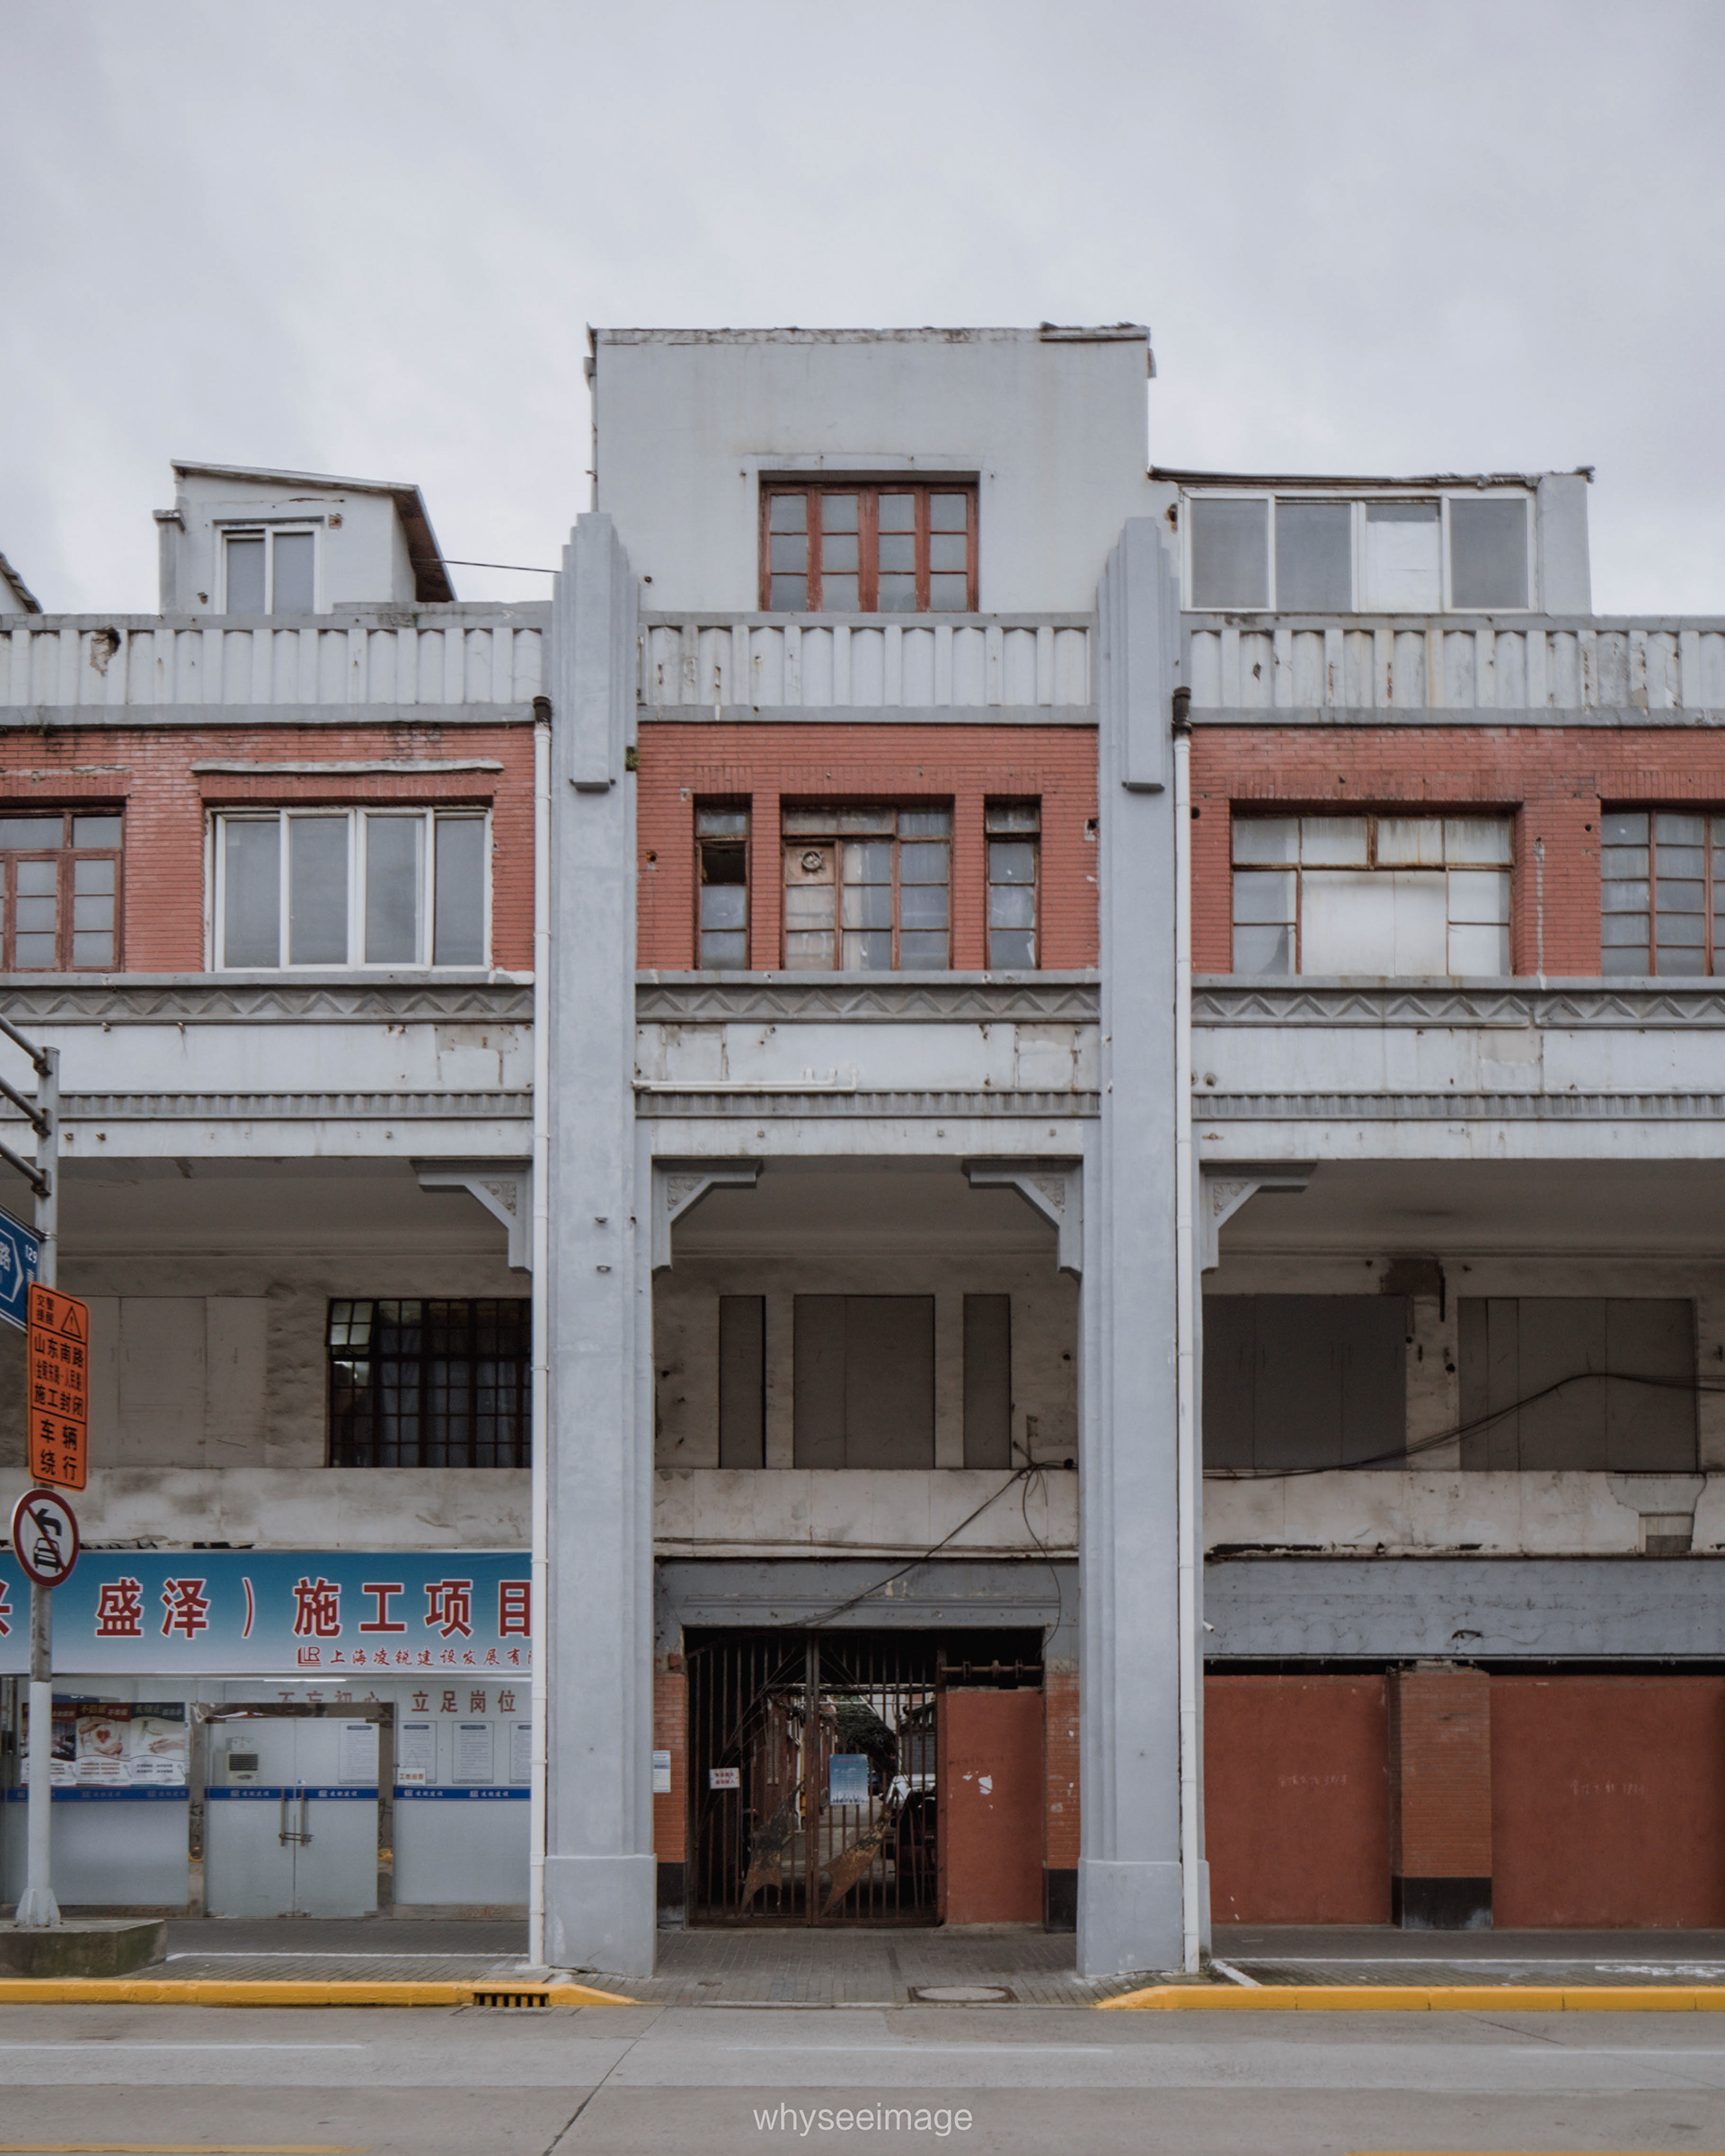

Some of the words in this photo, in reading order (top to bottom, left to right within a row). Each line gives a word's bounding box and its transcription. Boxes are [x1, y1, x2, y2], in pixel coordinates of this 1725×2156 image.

[34, 1332, 84, 1369] 山东南路
[34, 1383, 84, 1418] 施工封闭
[40, 1418, 78, 1452] 车辆
[40, 1449, 78, 1481] 绕行
[411, 1690, 516, 1713] 立足岗位
